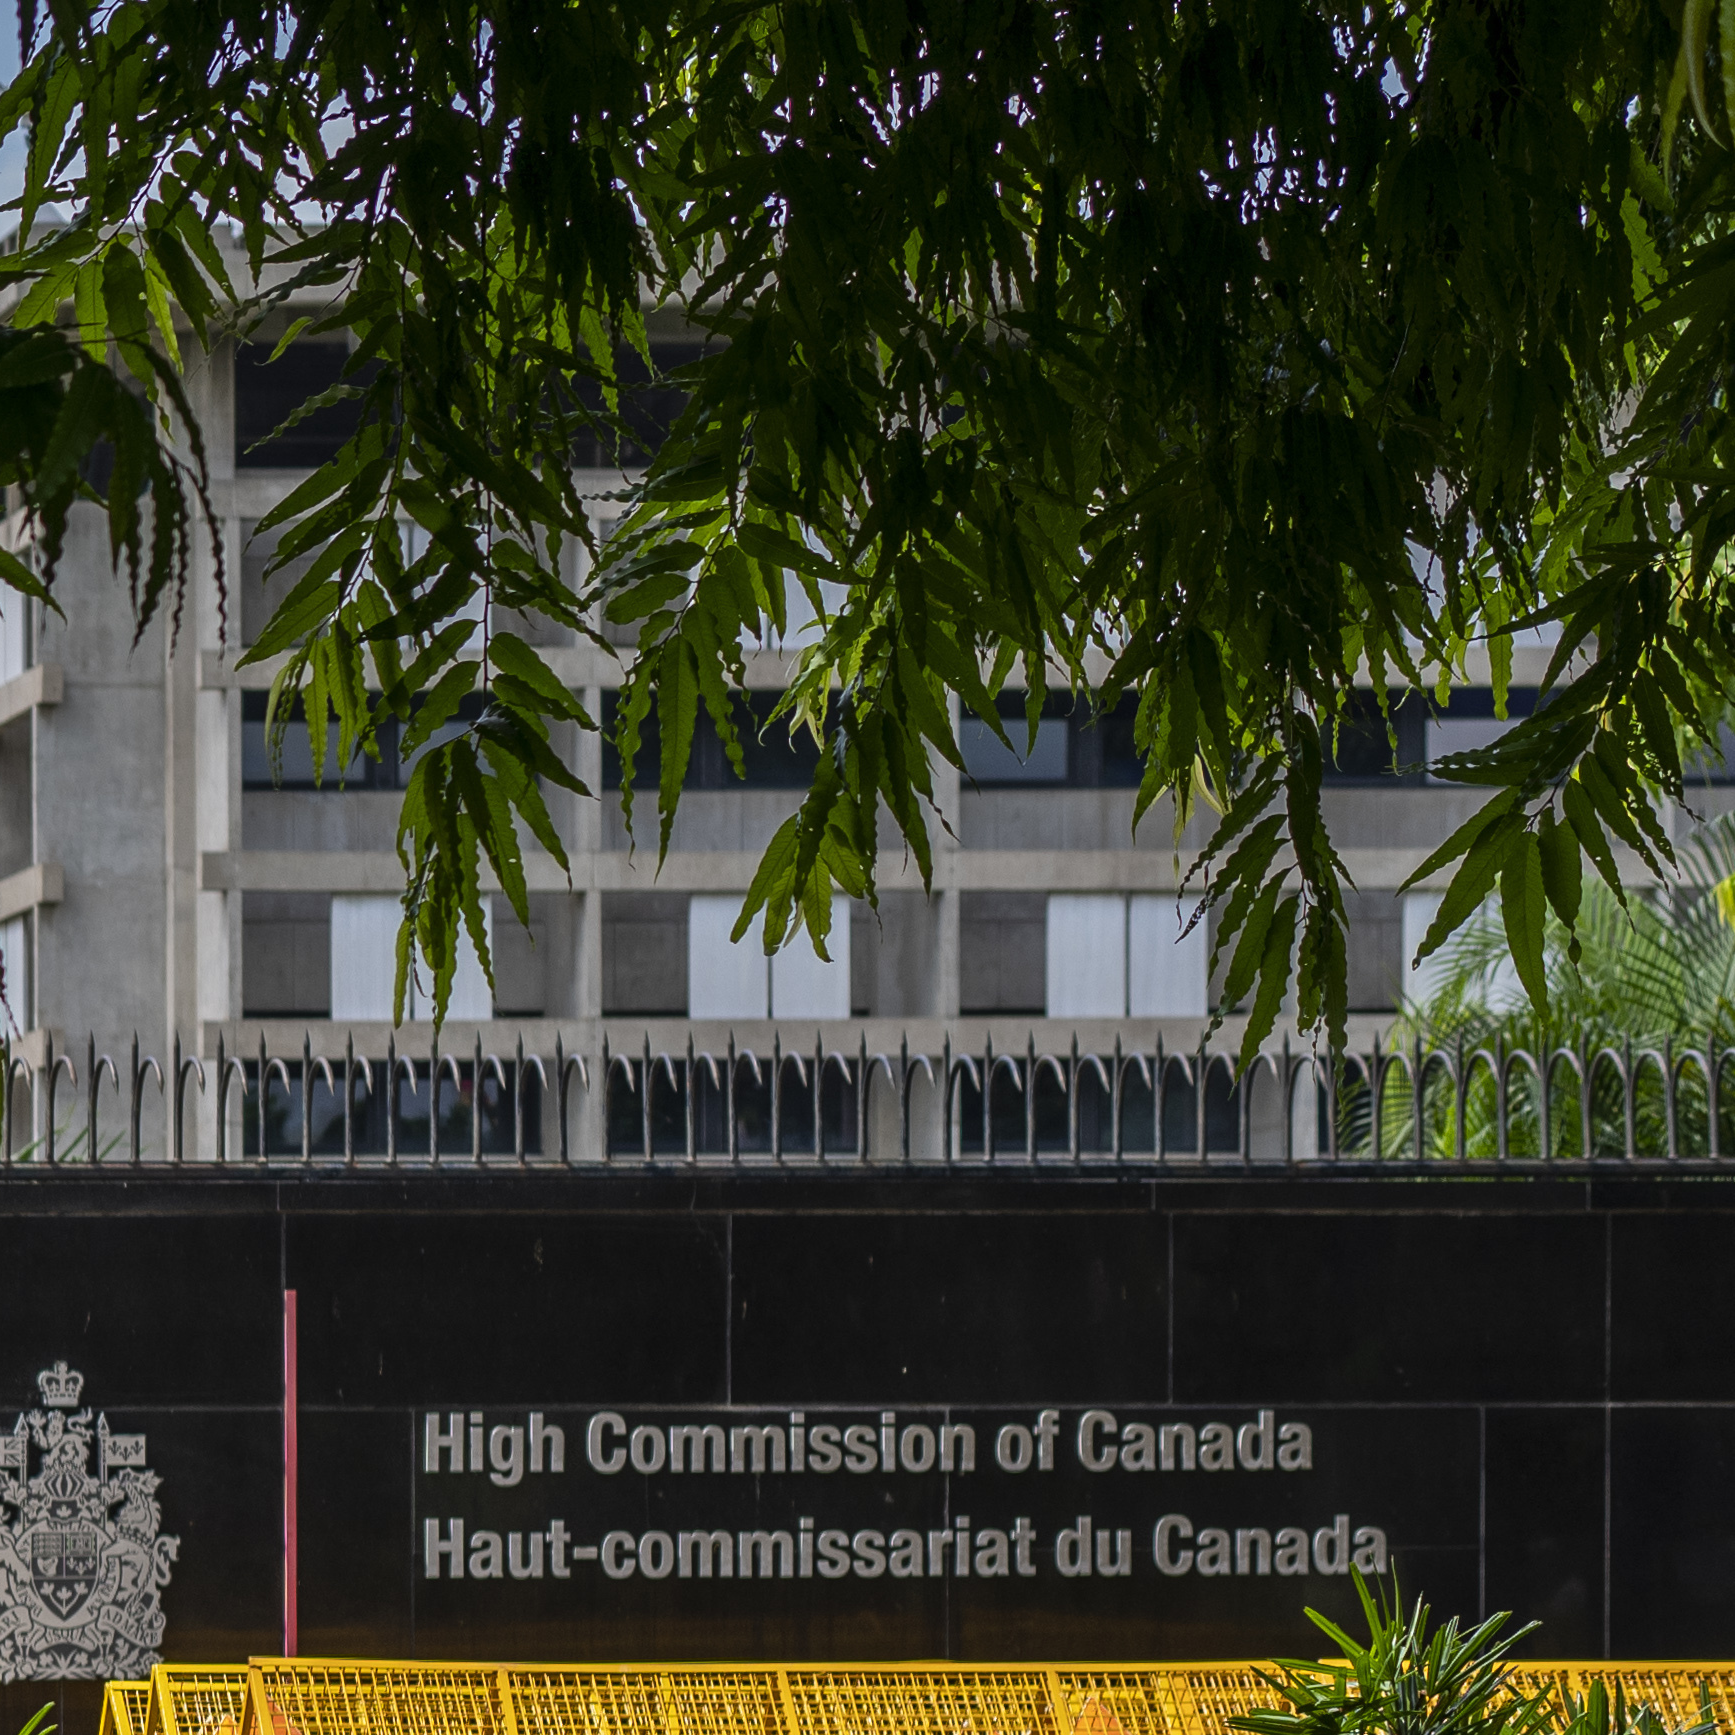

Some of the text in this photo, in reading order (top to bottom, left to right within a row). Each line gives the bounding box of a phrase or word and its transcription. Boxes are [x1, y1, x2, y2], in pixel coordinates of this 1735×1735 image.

[424, 1409, 1314, 1486] High Commission of Canada
[424, 1514, 1390, 1580] Haut-commissariat du Canada
